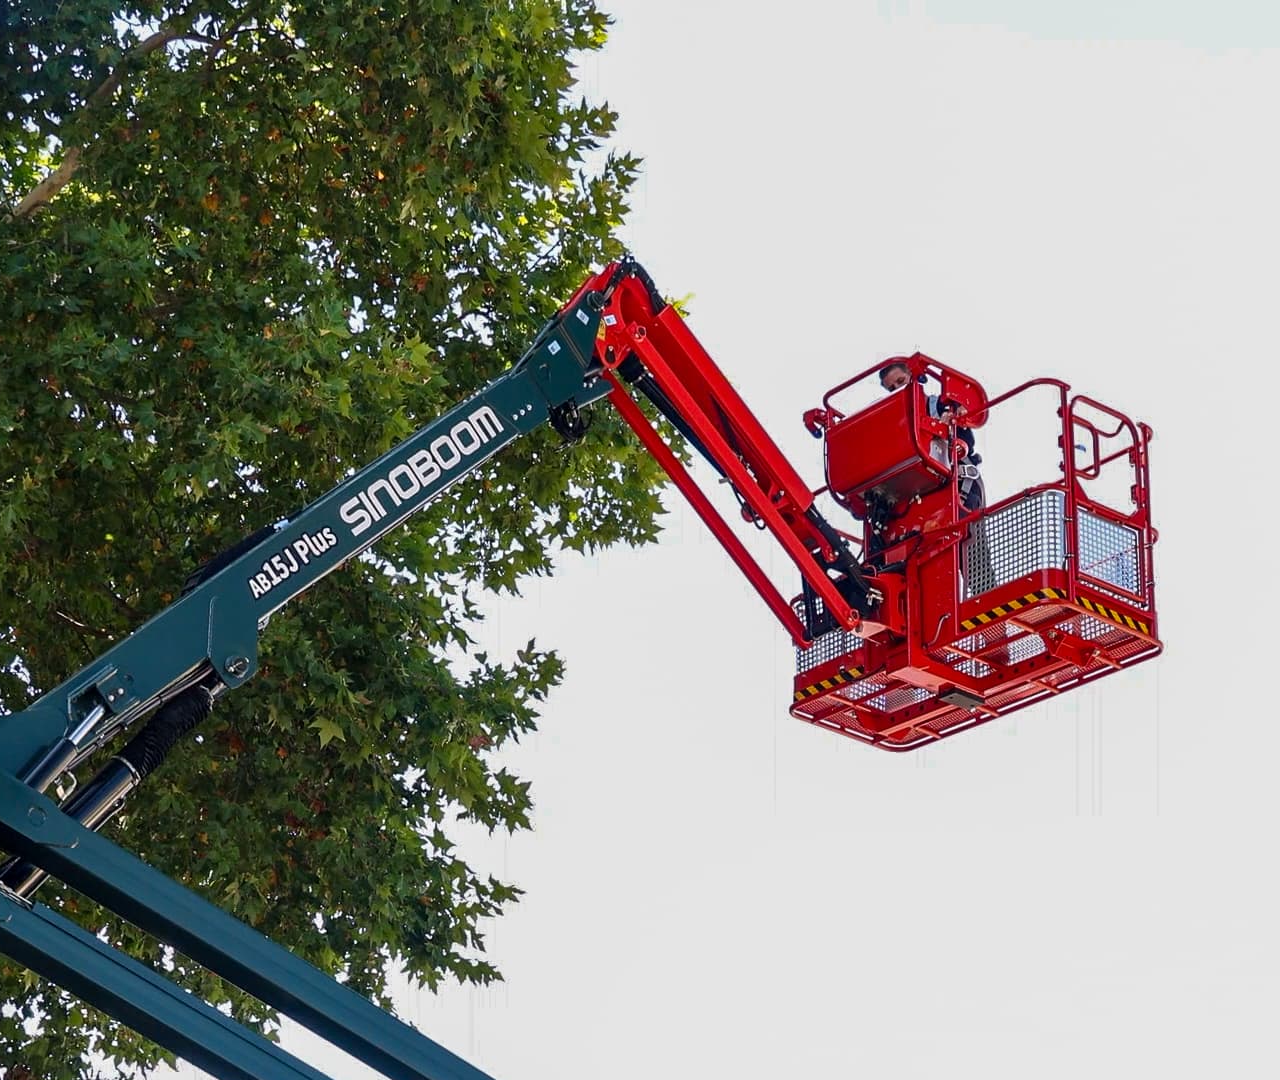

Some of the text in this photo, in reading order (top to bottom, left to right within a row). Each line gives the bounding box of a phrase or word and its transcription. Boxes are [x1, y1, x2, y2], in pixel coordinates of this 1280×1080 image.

[340, 405, 504, 537] SINOBOOM
[248, 527, 337, 599] AB15J Plus
